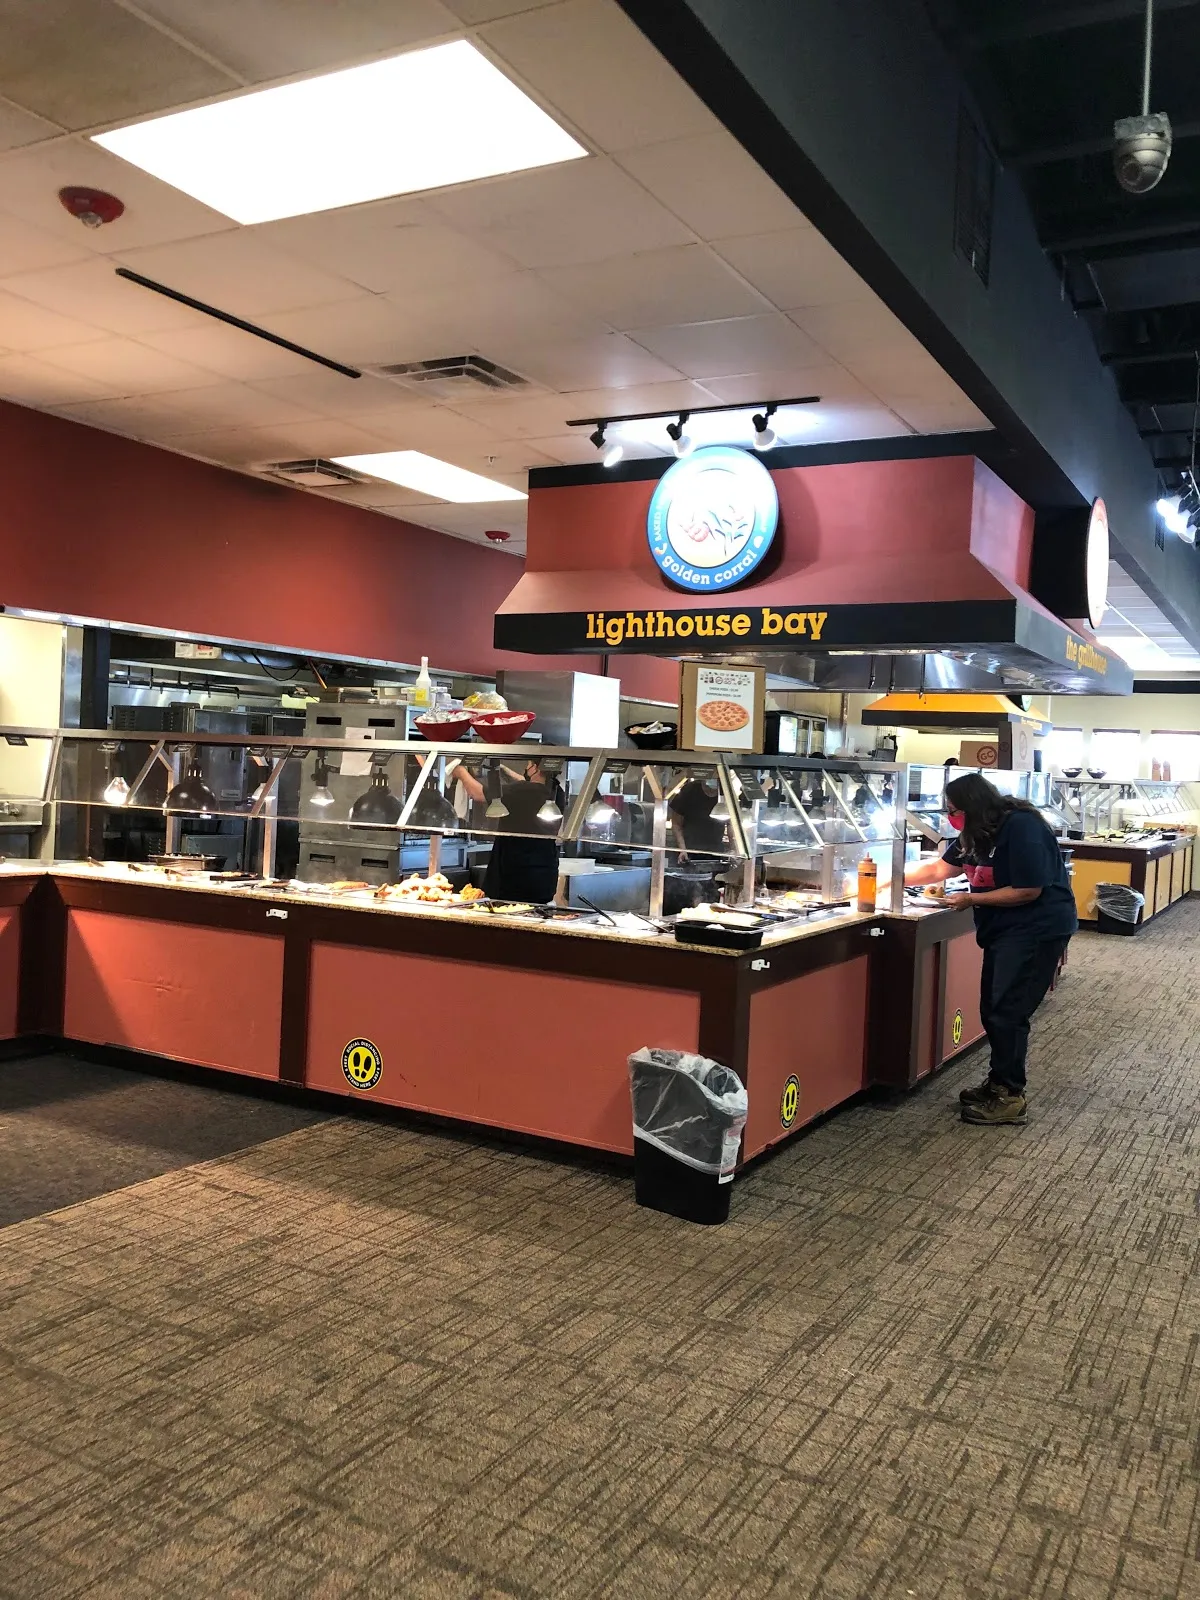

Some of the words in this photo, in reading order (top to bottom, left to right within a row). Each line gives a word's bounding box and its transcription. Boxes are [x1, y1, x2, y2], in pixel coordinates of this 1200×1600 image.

[662, 555, 710, 584] golden
[714, 548, 758, 583] corral
[586, 611, 751, 646] lighthouse
[760, 608, 828, 640] bay
[1066, 634, 1077, 662] the
[980, 750, 994, 760] GC
